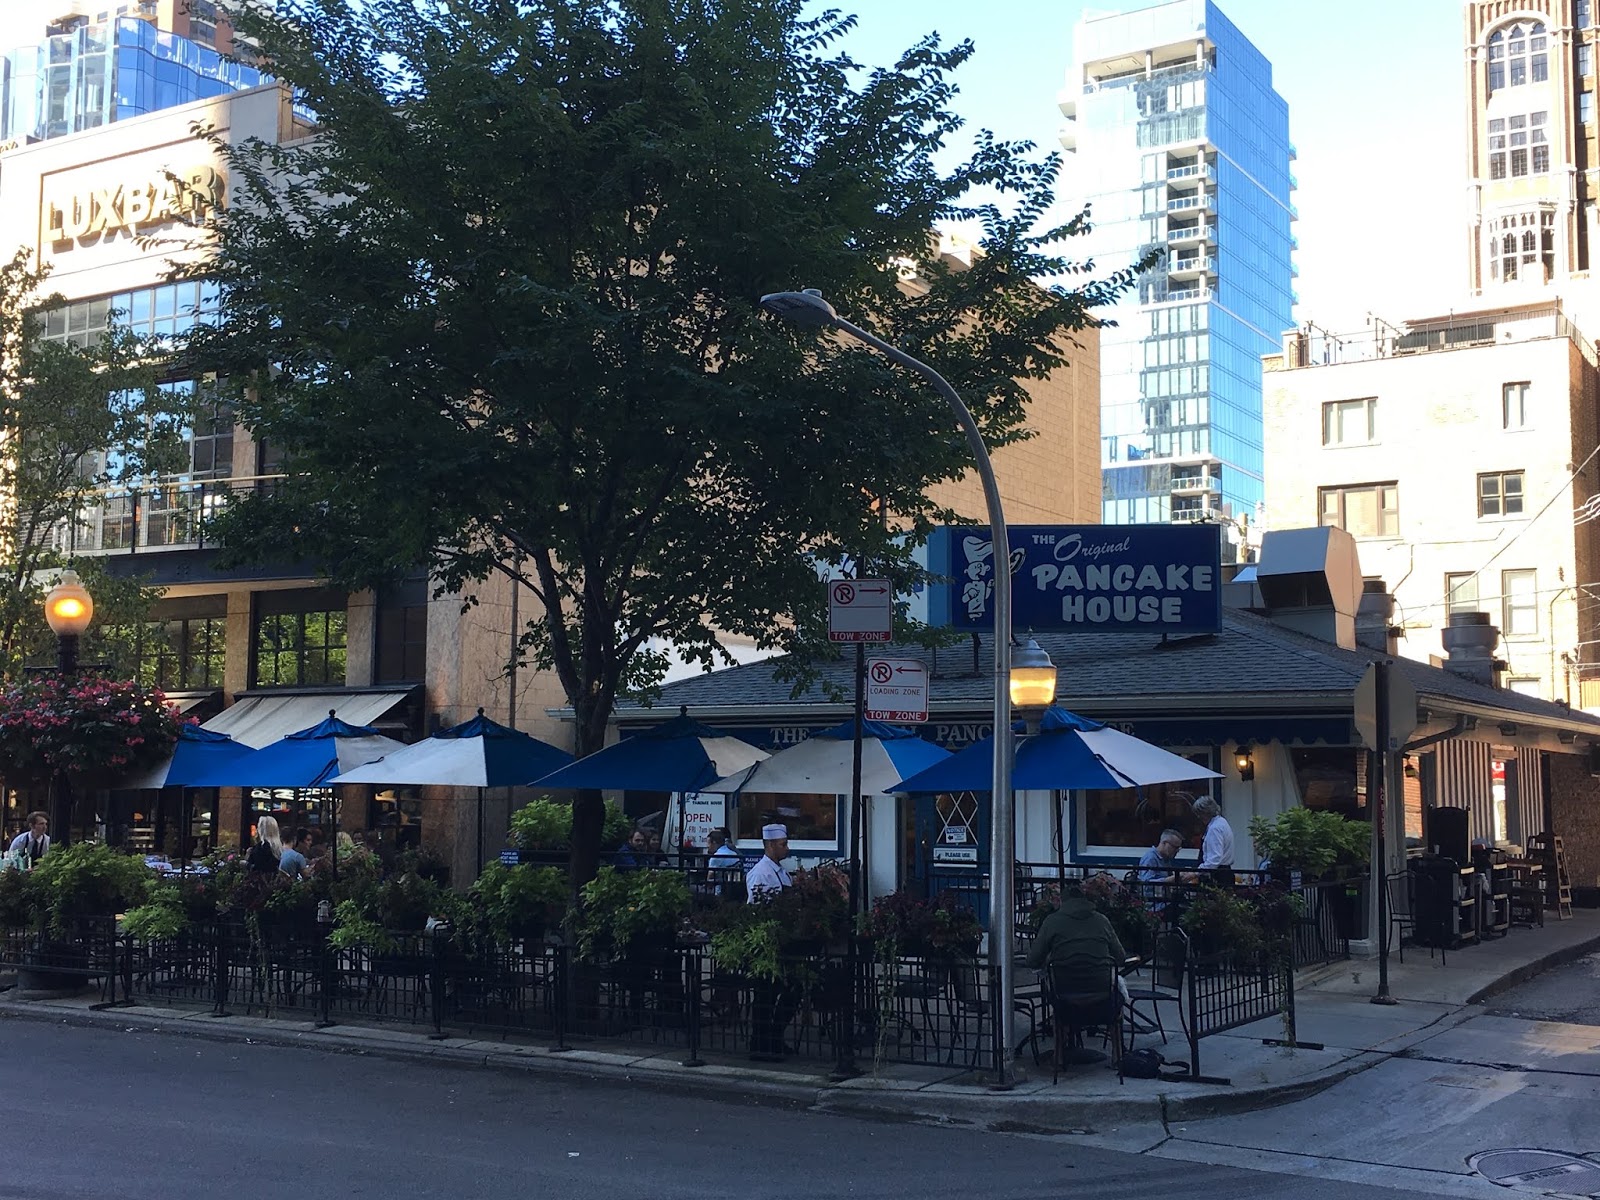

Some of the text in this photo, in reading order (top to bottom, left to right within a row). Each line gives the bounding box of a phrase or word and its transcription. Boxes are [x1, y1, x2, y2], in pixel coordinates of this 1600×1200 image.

[43, 165, 217, 243] LUXBAR
[1031, 533, 1131, 562] THE Original
[1031, 563, 1213, 592] PANCAKE
[1062, 594, 1183, 623] HOUSE
[833, 632, 885, 641] TOW ZONE
[870, 687, 920, 696] LOADING ZONE
[869, 711, 921, 721] TOW ZONE
[770, 727, 810, 743] THE
[935, 724, 993, 741] PANC
[686, 813, 712, 823] OPEN
